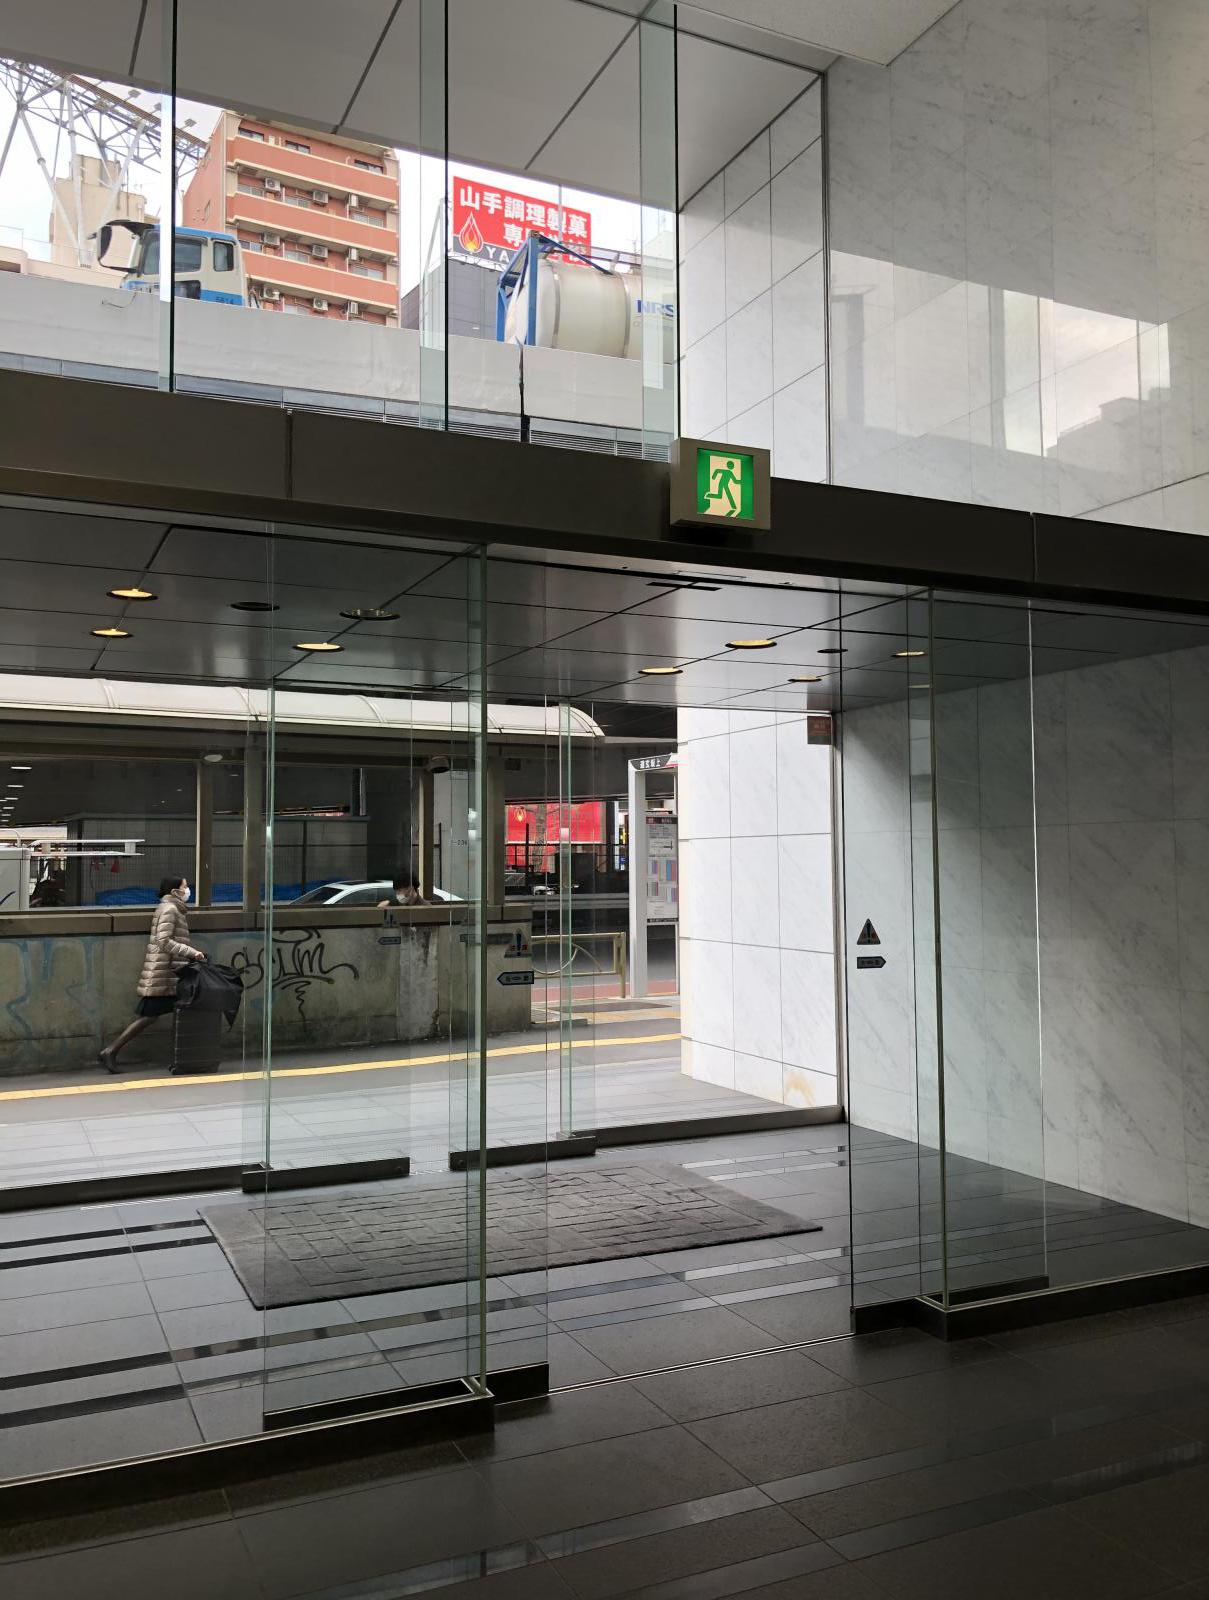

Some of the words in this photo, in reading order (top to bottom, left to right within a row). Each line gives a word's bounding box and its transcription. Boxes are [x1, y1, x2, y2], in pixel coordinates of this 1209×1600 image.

[460, 186, 587, 238] 山手調理製菓
